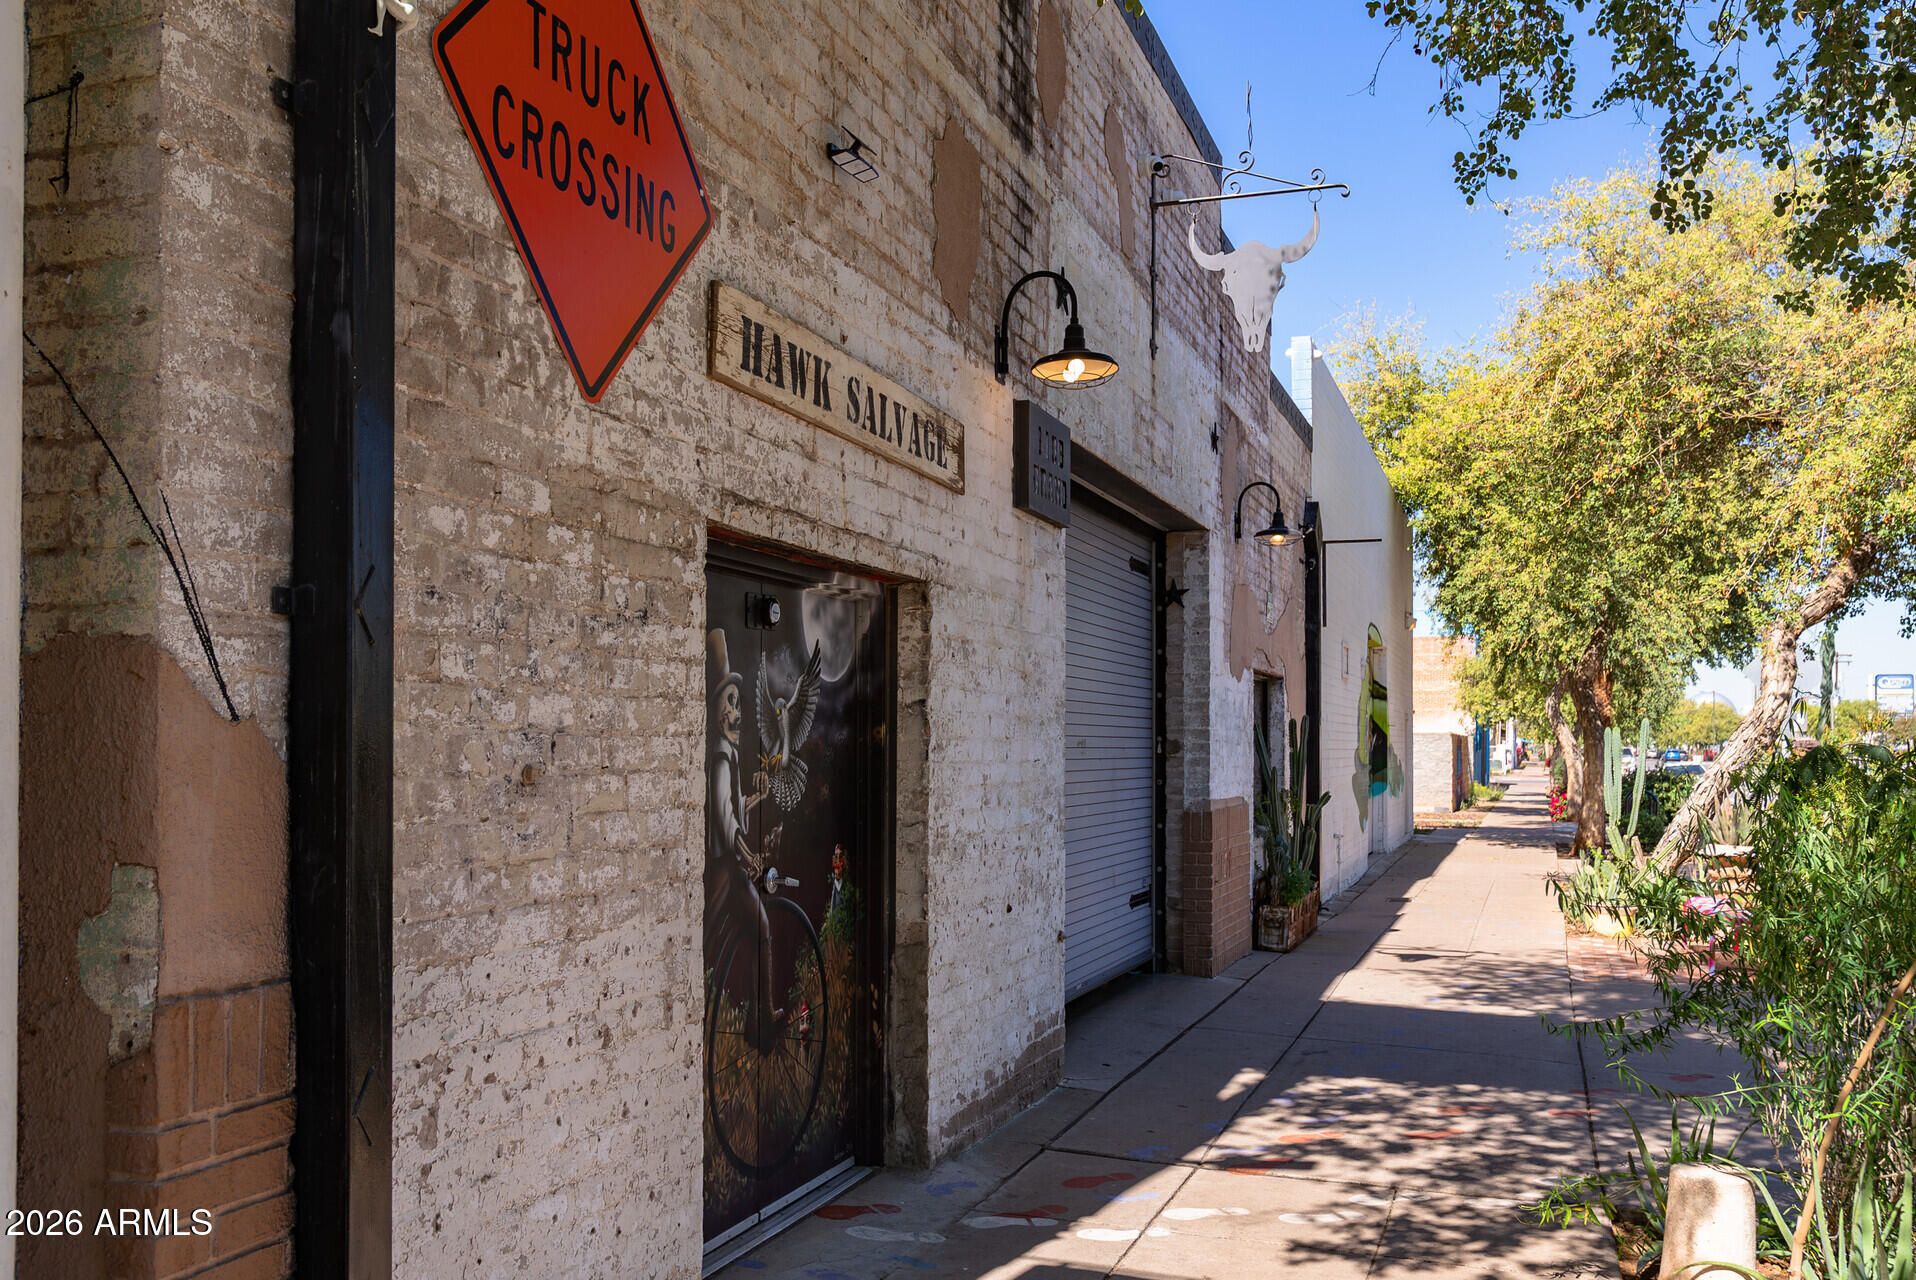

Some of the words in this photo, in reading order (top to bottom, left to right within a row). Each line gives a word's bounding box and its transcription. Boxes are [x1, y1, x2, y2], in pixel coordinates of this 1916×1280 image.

[526, 0, 651, 145] TRUCK
[493, 85, 676, 253] CROSSING
[740, 315, 832, 412] HAWK
[846, 376, 948, 469] SALVAGE
